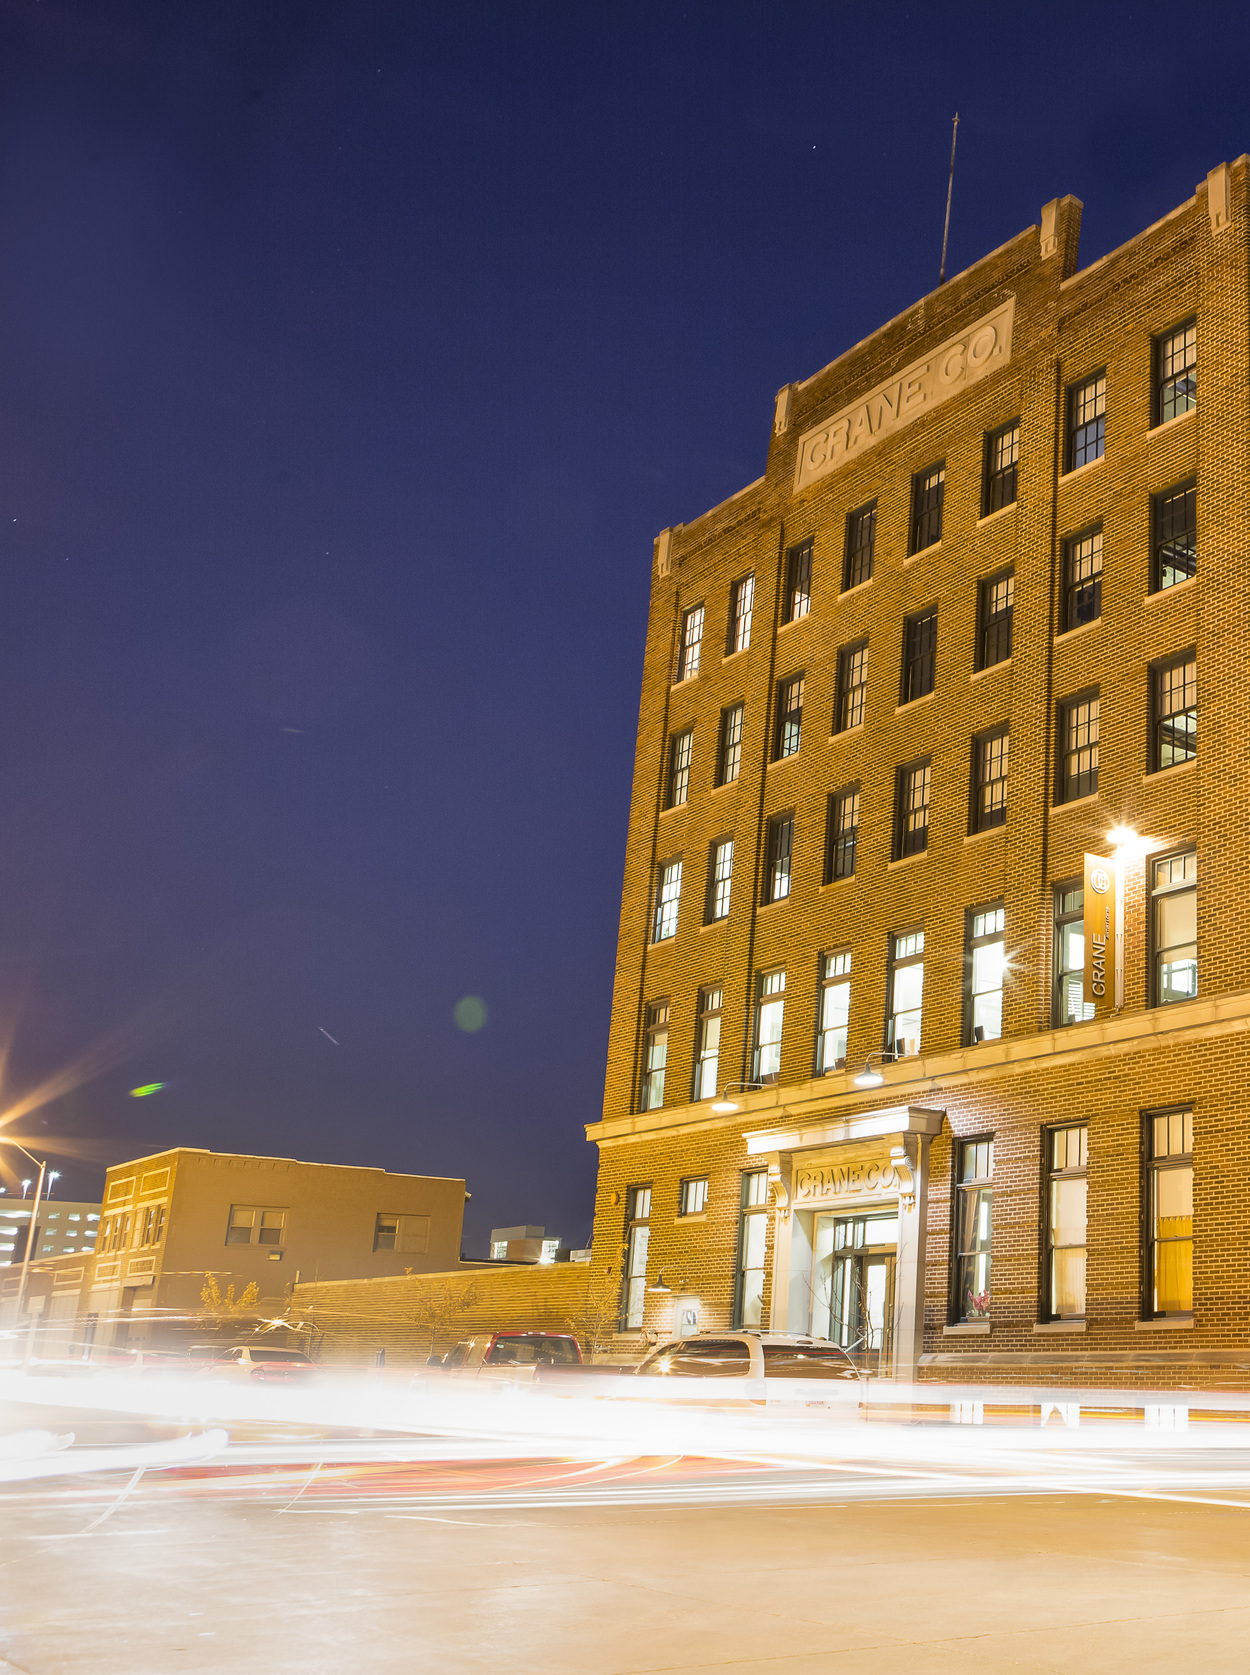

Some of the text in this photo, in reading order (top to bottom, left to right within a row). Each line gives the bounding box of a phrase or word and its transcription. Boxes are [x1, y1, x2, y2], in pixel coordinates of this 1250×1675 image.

[806, 363, 930, 471] CRANE
[1092, 932, 1106, 997] CRANE
[799, 1164, 864, 1199] CRANE
